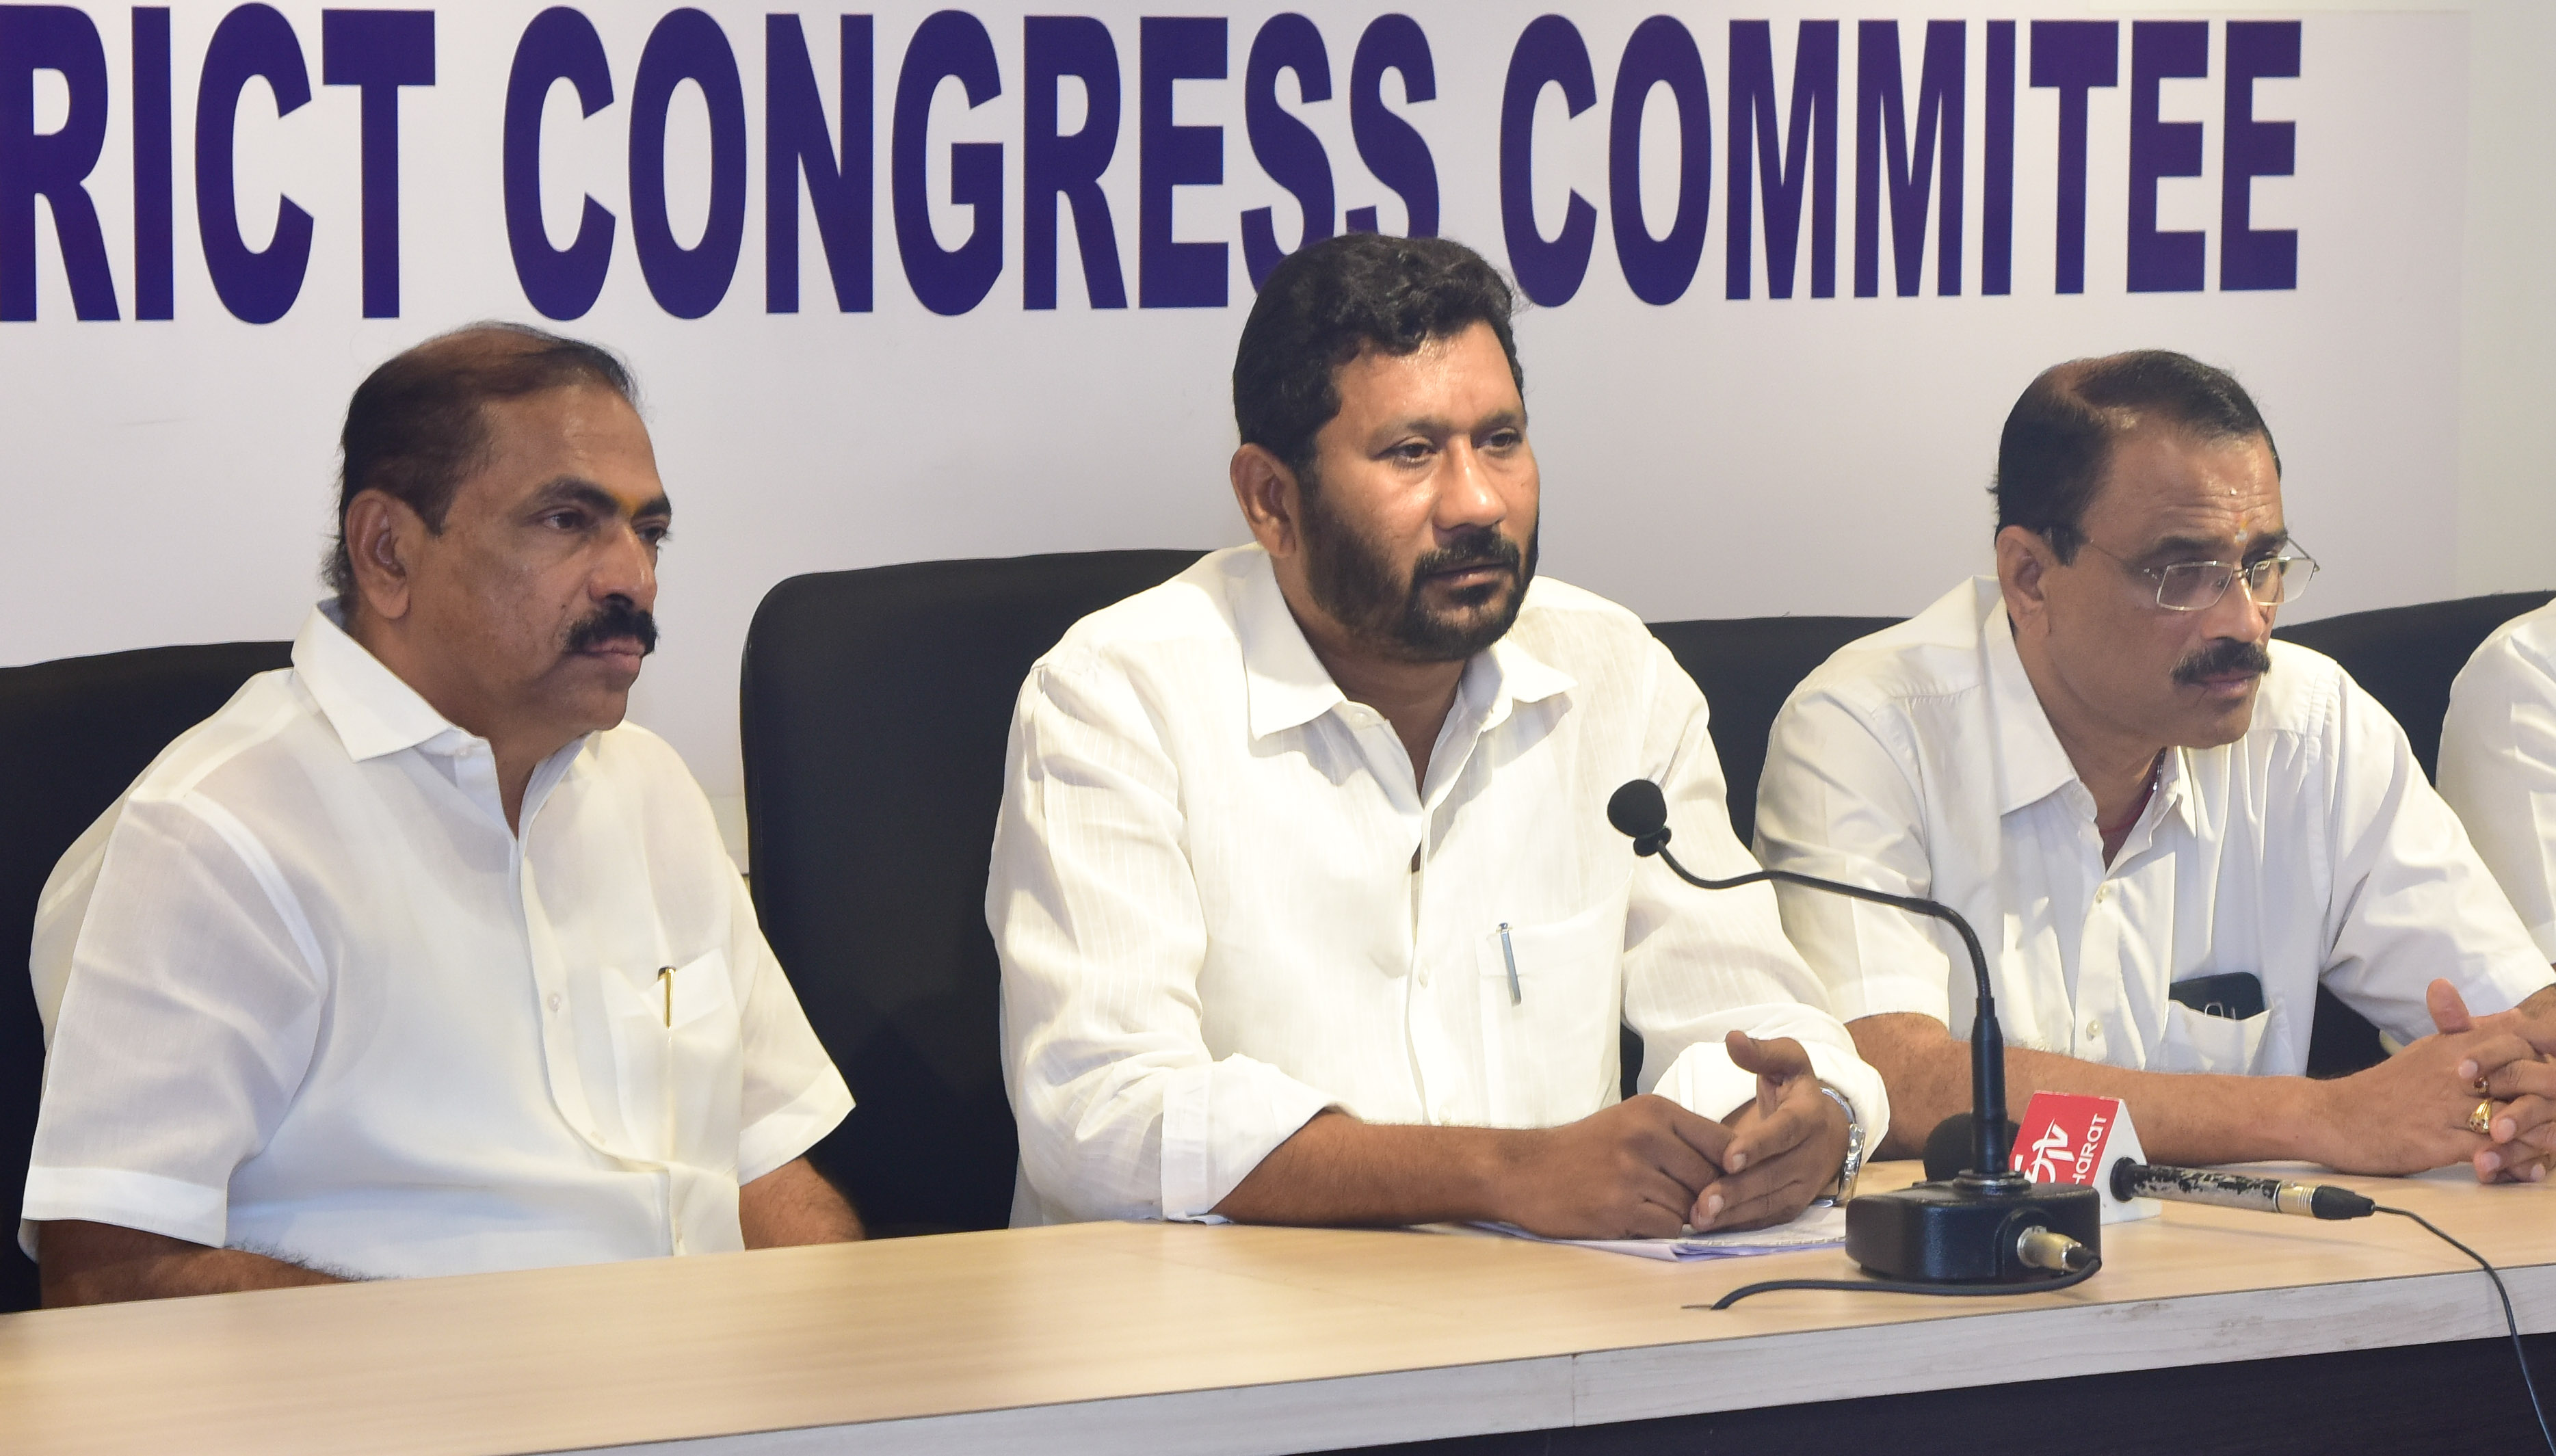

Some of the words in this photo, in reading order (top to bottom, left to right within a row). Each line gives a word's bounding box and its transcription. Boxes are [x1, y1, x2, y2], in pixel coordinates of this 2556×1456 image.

[0, 3, 436, 324] RICT
[503, 5, 1441, 321] CONGRESS
[1500, 12, 2302, 308] COMMITEE
